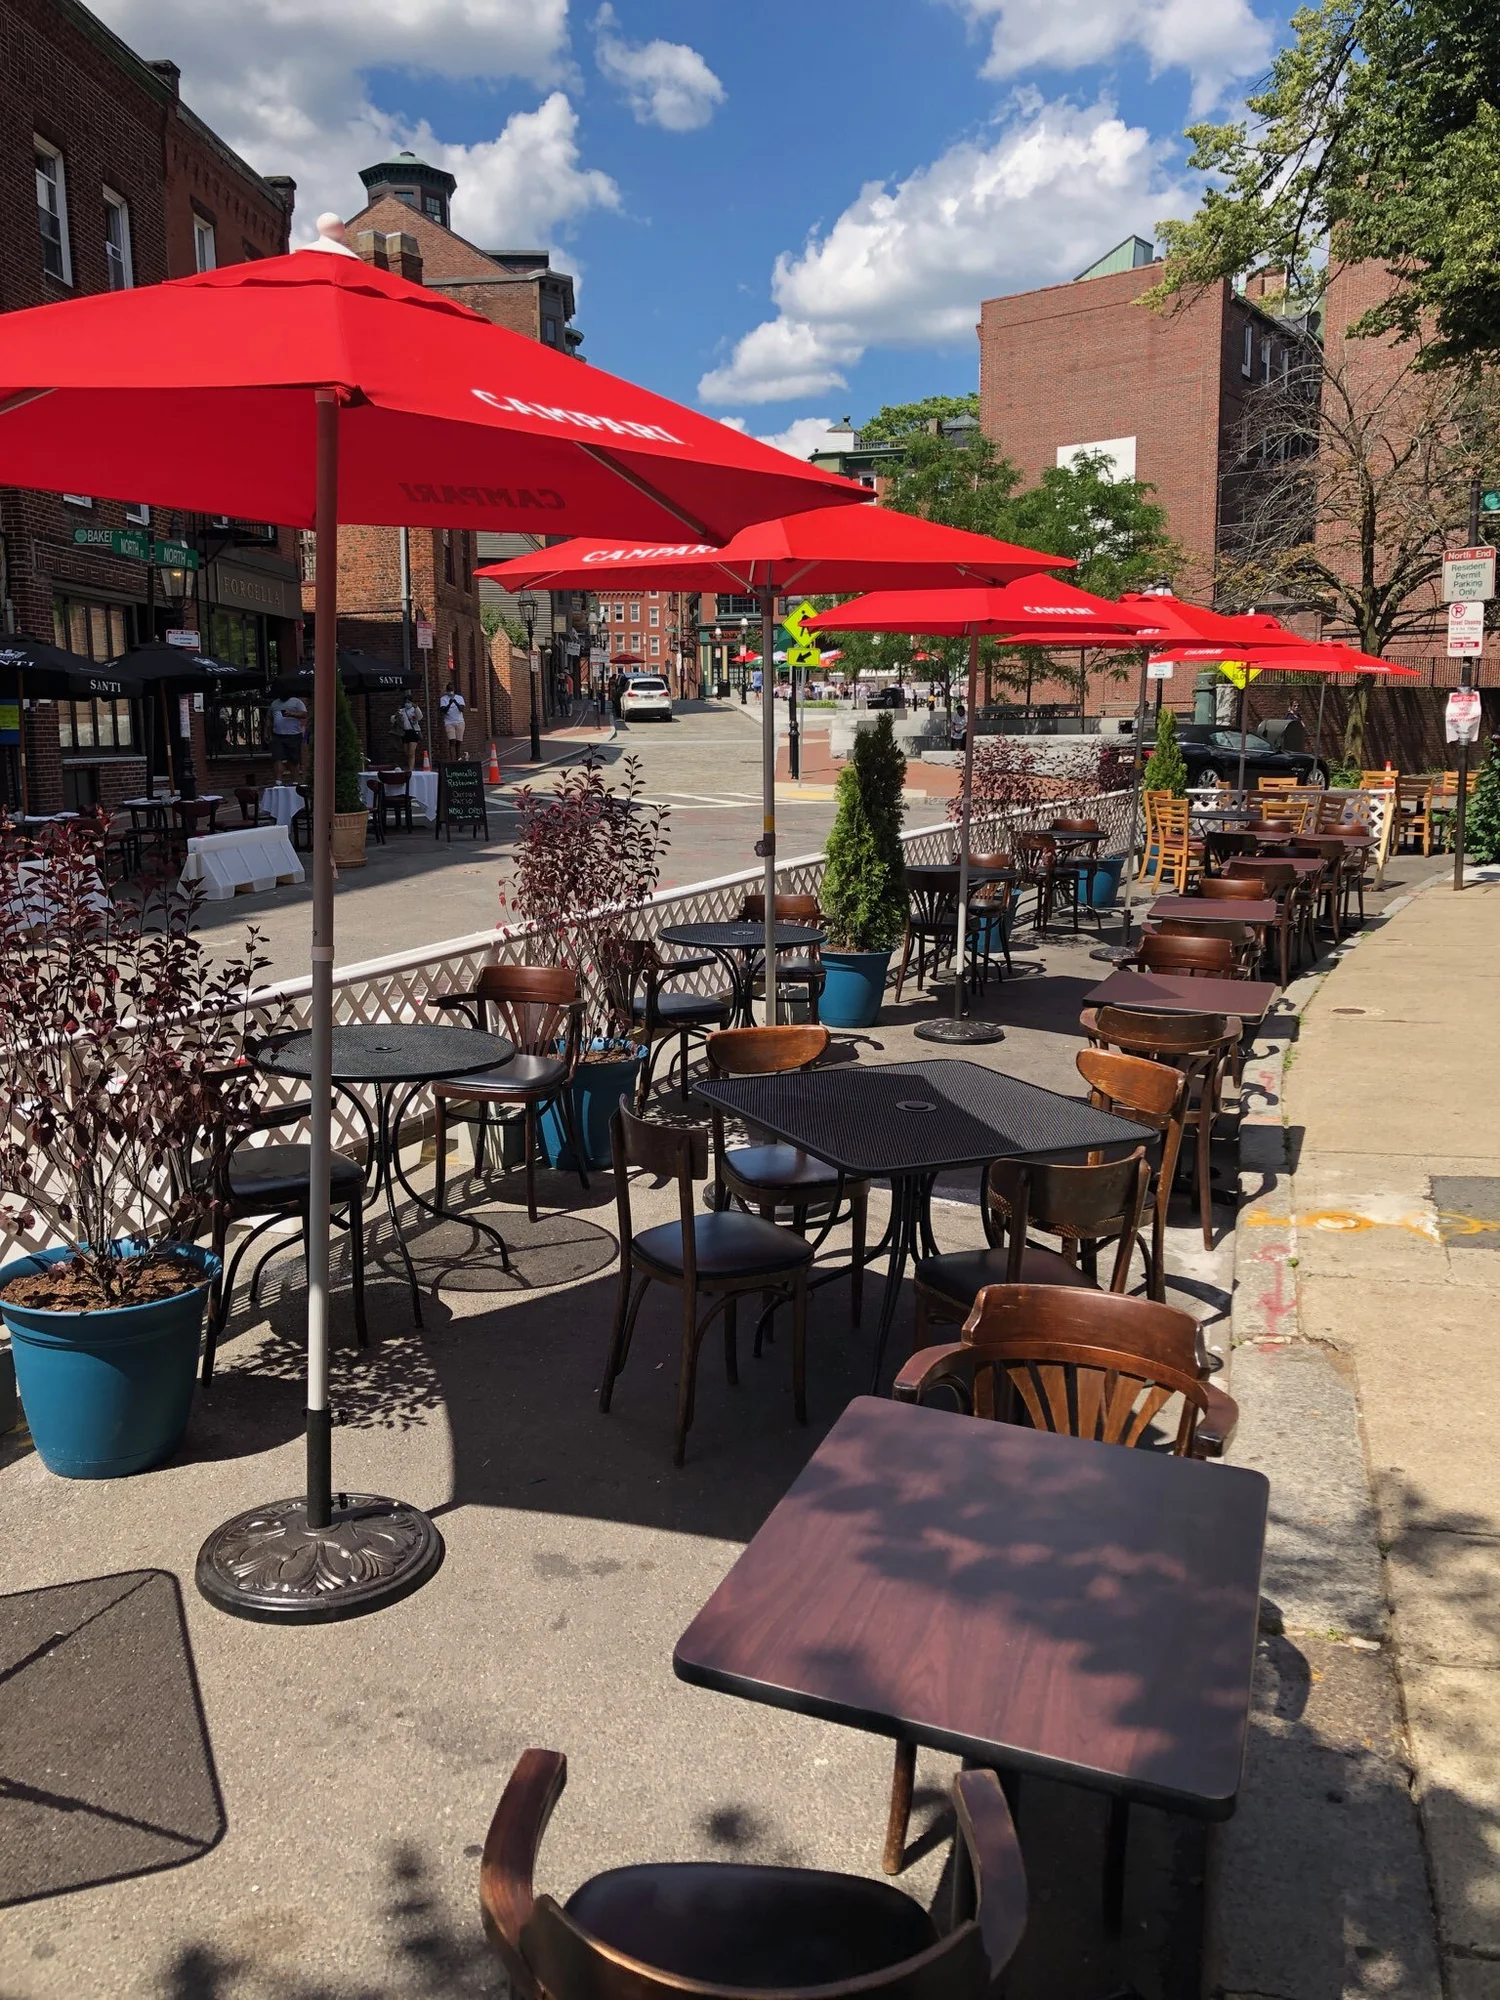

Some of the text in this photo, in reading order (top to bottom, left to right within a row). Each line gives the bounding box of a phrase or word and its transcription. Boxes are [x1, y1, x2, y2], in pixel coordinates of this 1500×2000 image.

[471, 389, 685, 444] CAMPARI
[120, 538, 139, 557] NORTH
[163, 547, 186, 566] NORTH
[1448, 549, 1491, 560] North End
[1451, 562, 1486, 571] Resident
[1453, 580, 1483, 588] Parking
[223, 576, 280, 606] FORCELLA
[1459, 588, 1477, 596] Only
[1023, 606, 1096, 615] CAMPARI
[90, 679, 121, 692] SANTI
[379, 676, 403, 685] SANTI
